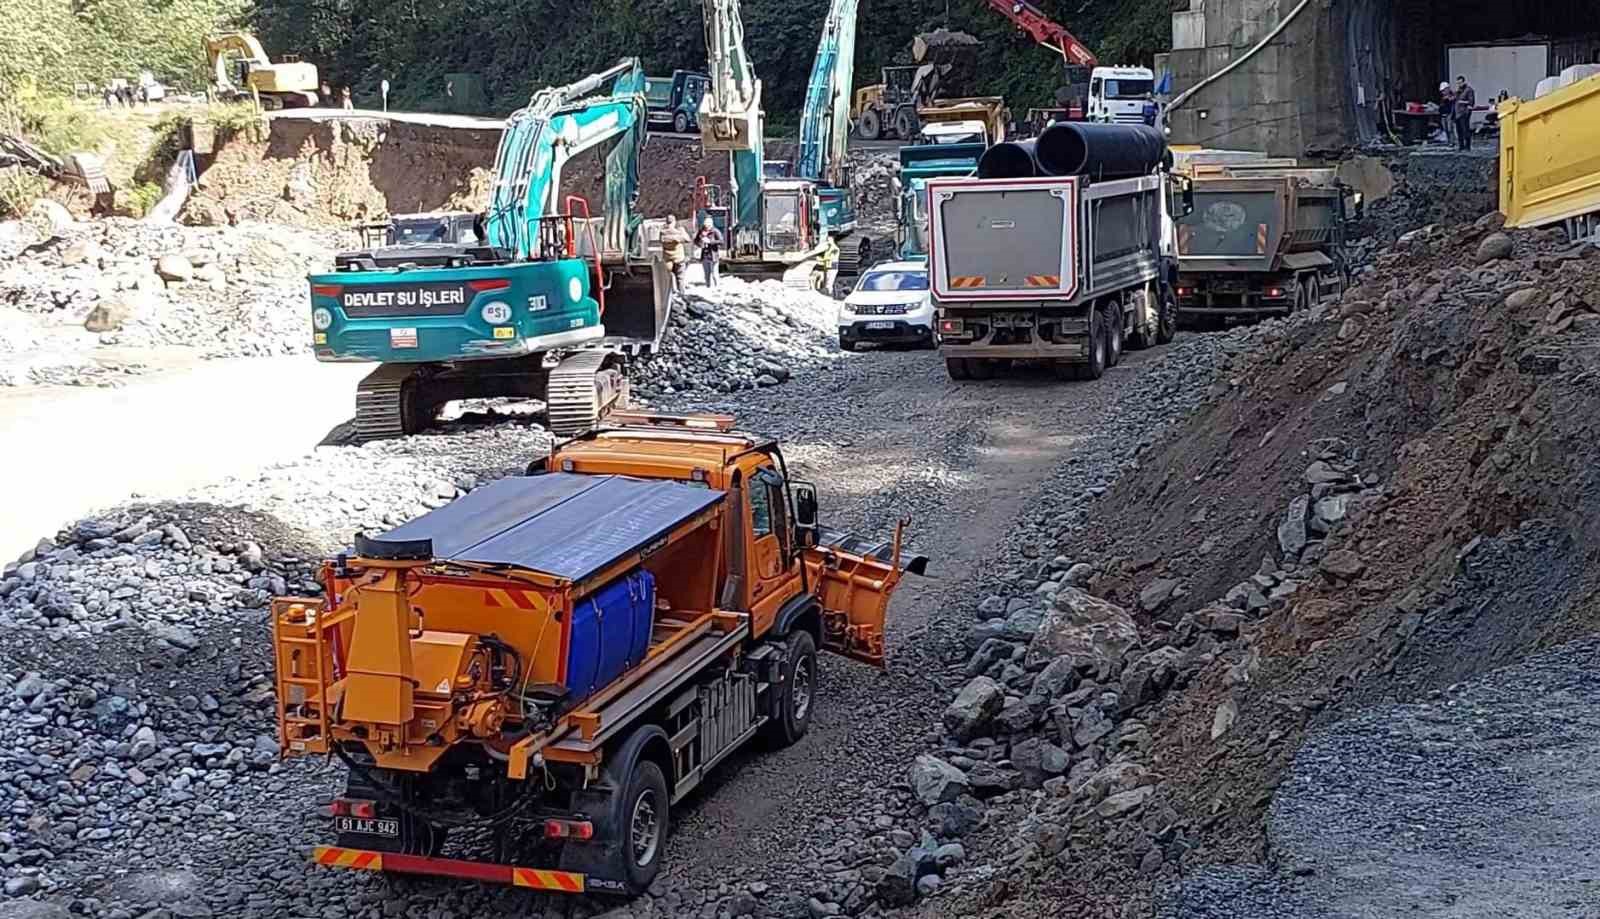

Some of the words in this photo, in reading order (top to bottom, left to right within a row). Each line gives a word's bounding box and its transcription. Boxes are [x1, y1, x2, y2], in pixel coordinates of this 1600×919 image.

[344, 292, 395, 307] DEVLET
[397, 291, 417, 306] SU
[419, 287, 464, 308] İŞLERİ
[342, 819, 352, 830] 61
[357, 820, 374, 832] AJC
[377, 822, 395, 834] 942
